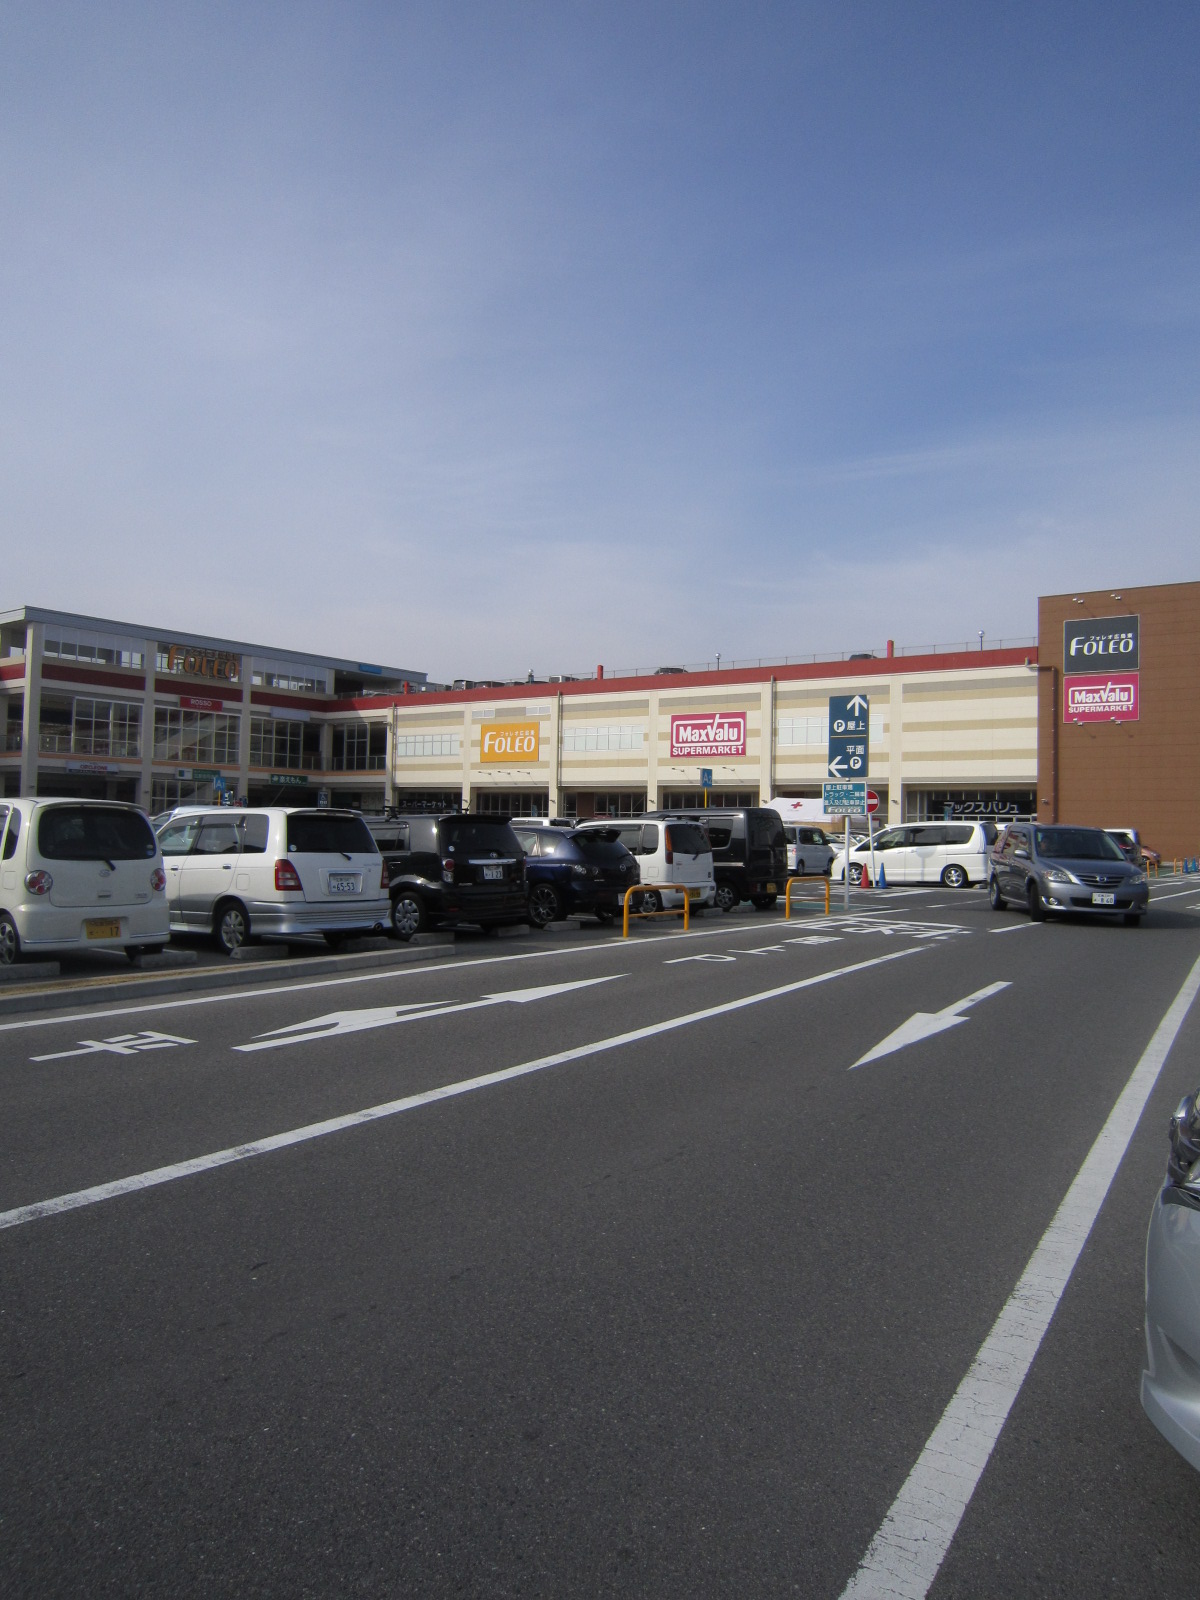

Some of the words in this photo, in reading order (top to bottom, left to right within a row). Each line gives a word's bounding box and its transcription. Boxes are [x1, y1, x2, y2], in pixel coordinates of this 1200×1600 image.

[1069, 636, 1134, 656] FOLEO
[1074, 682, 1128, 703] MaxValu
[1068, 705, 1133, 713] SUPERMARKET
[679, 714, 738, 742] MaxValu
[846, 720, 866, 731] 屋上
[483, 731, 535, 753] FOLEO
[672, 746, 744, 755] SUPERMARKET
[846, 745, 865, 755] 平面
[402, 800, 447, 808] スーパーマーケット
[943, 801, 1019, 813] マックスバリュ
